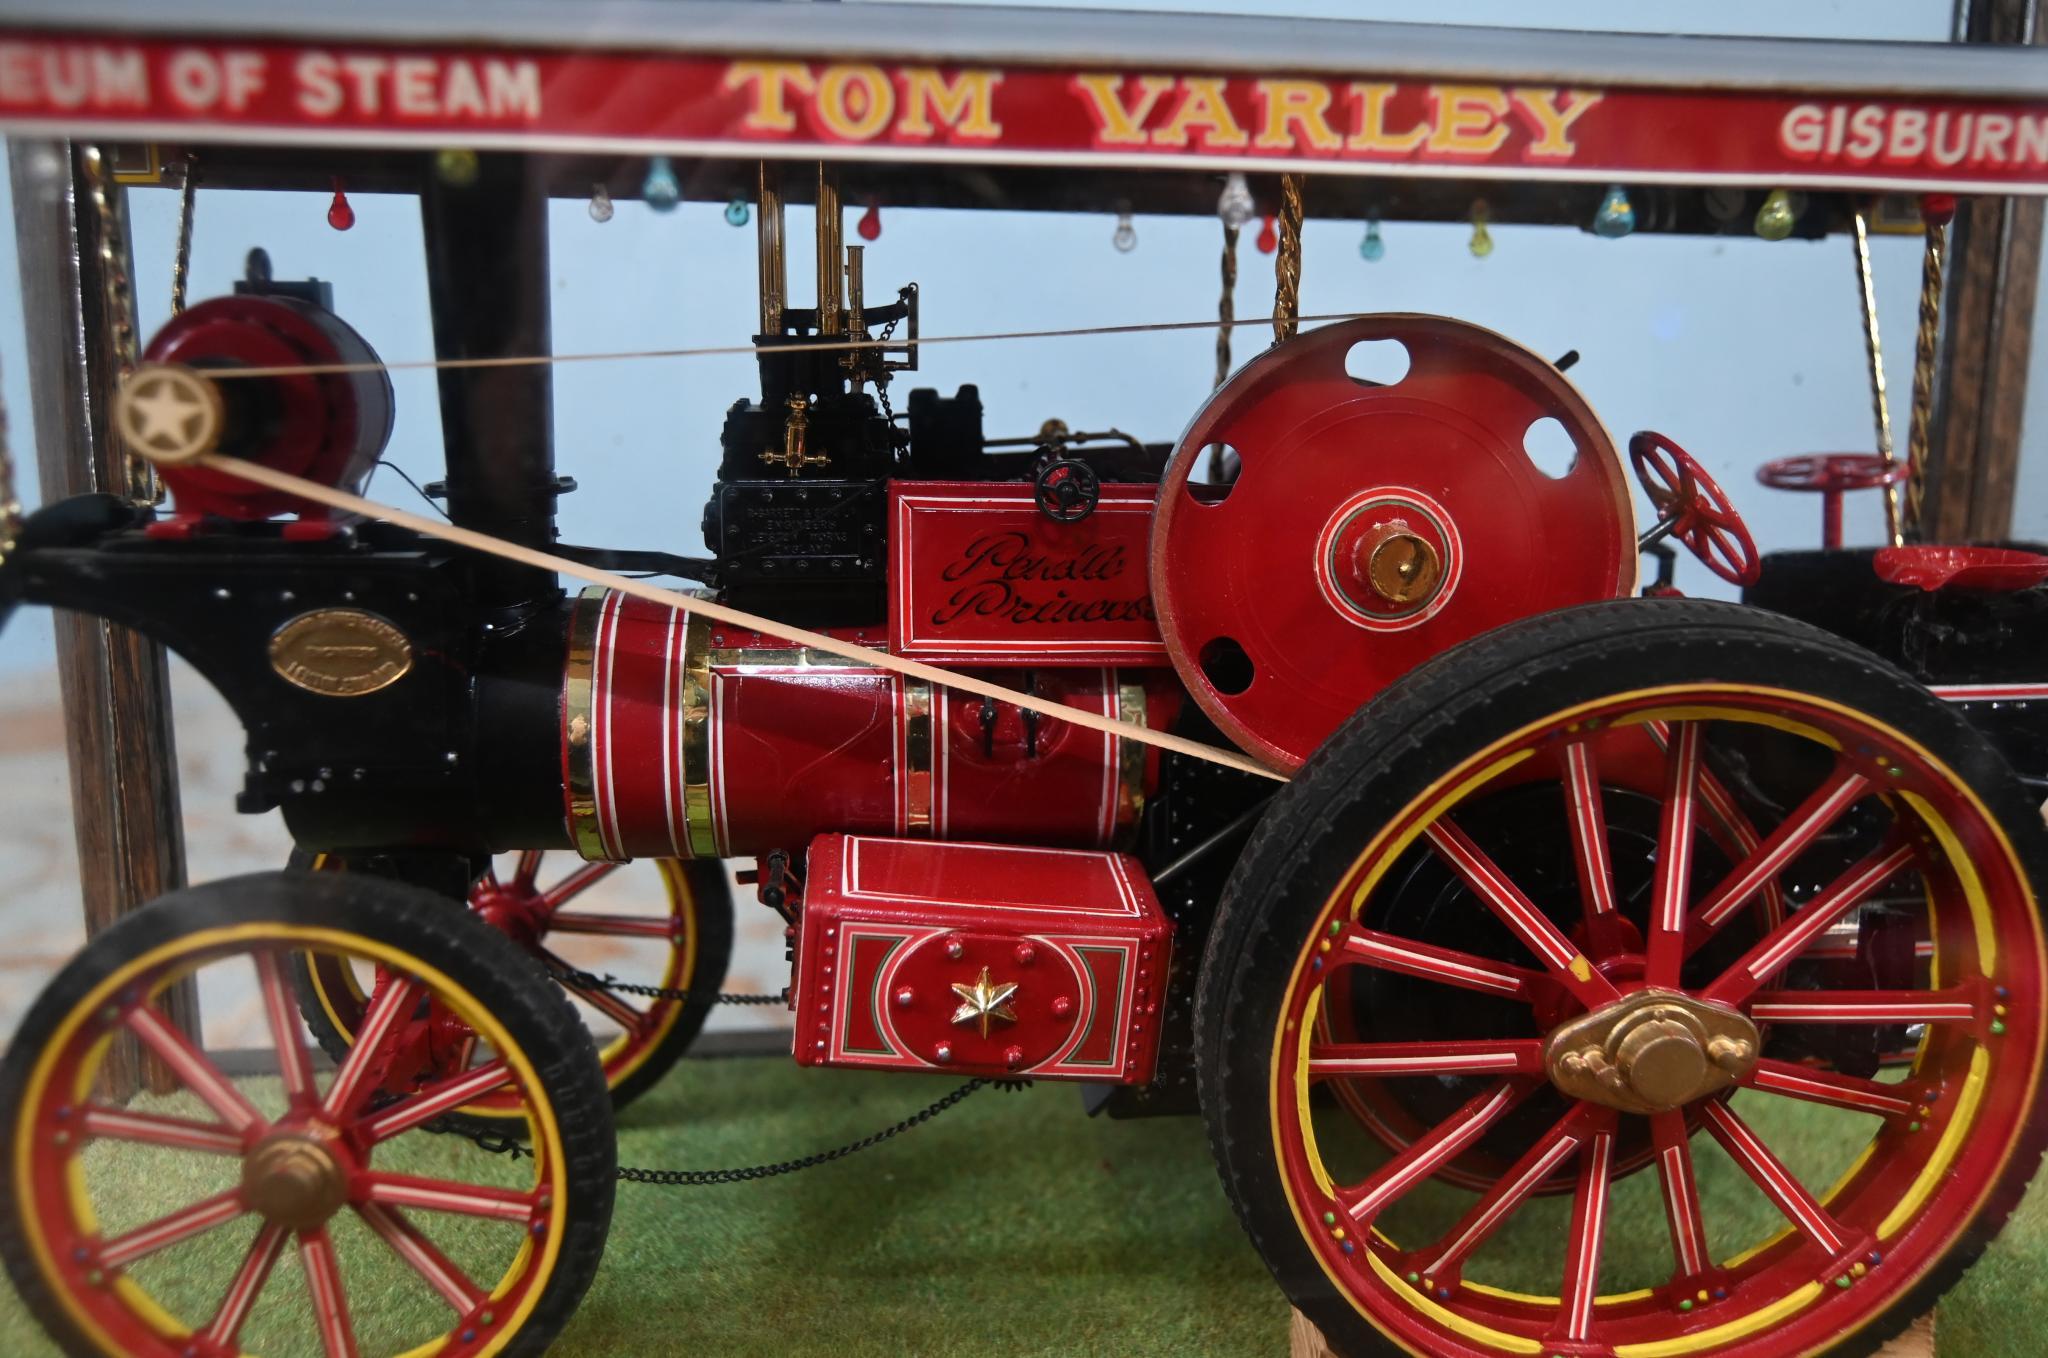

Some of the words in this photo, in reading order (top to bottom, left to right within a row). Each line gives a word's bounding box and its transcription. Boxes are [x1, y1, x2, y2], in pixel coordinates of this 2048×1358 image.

[170, 49, 267, 108] OF
[294, 52, 542, 120] STEAM
[725, 61, 1003, 140] TOM
[1074, 72, 1603, 158] VARLEY
[1781, 104, 2048, 166] GISBURN
